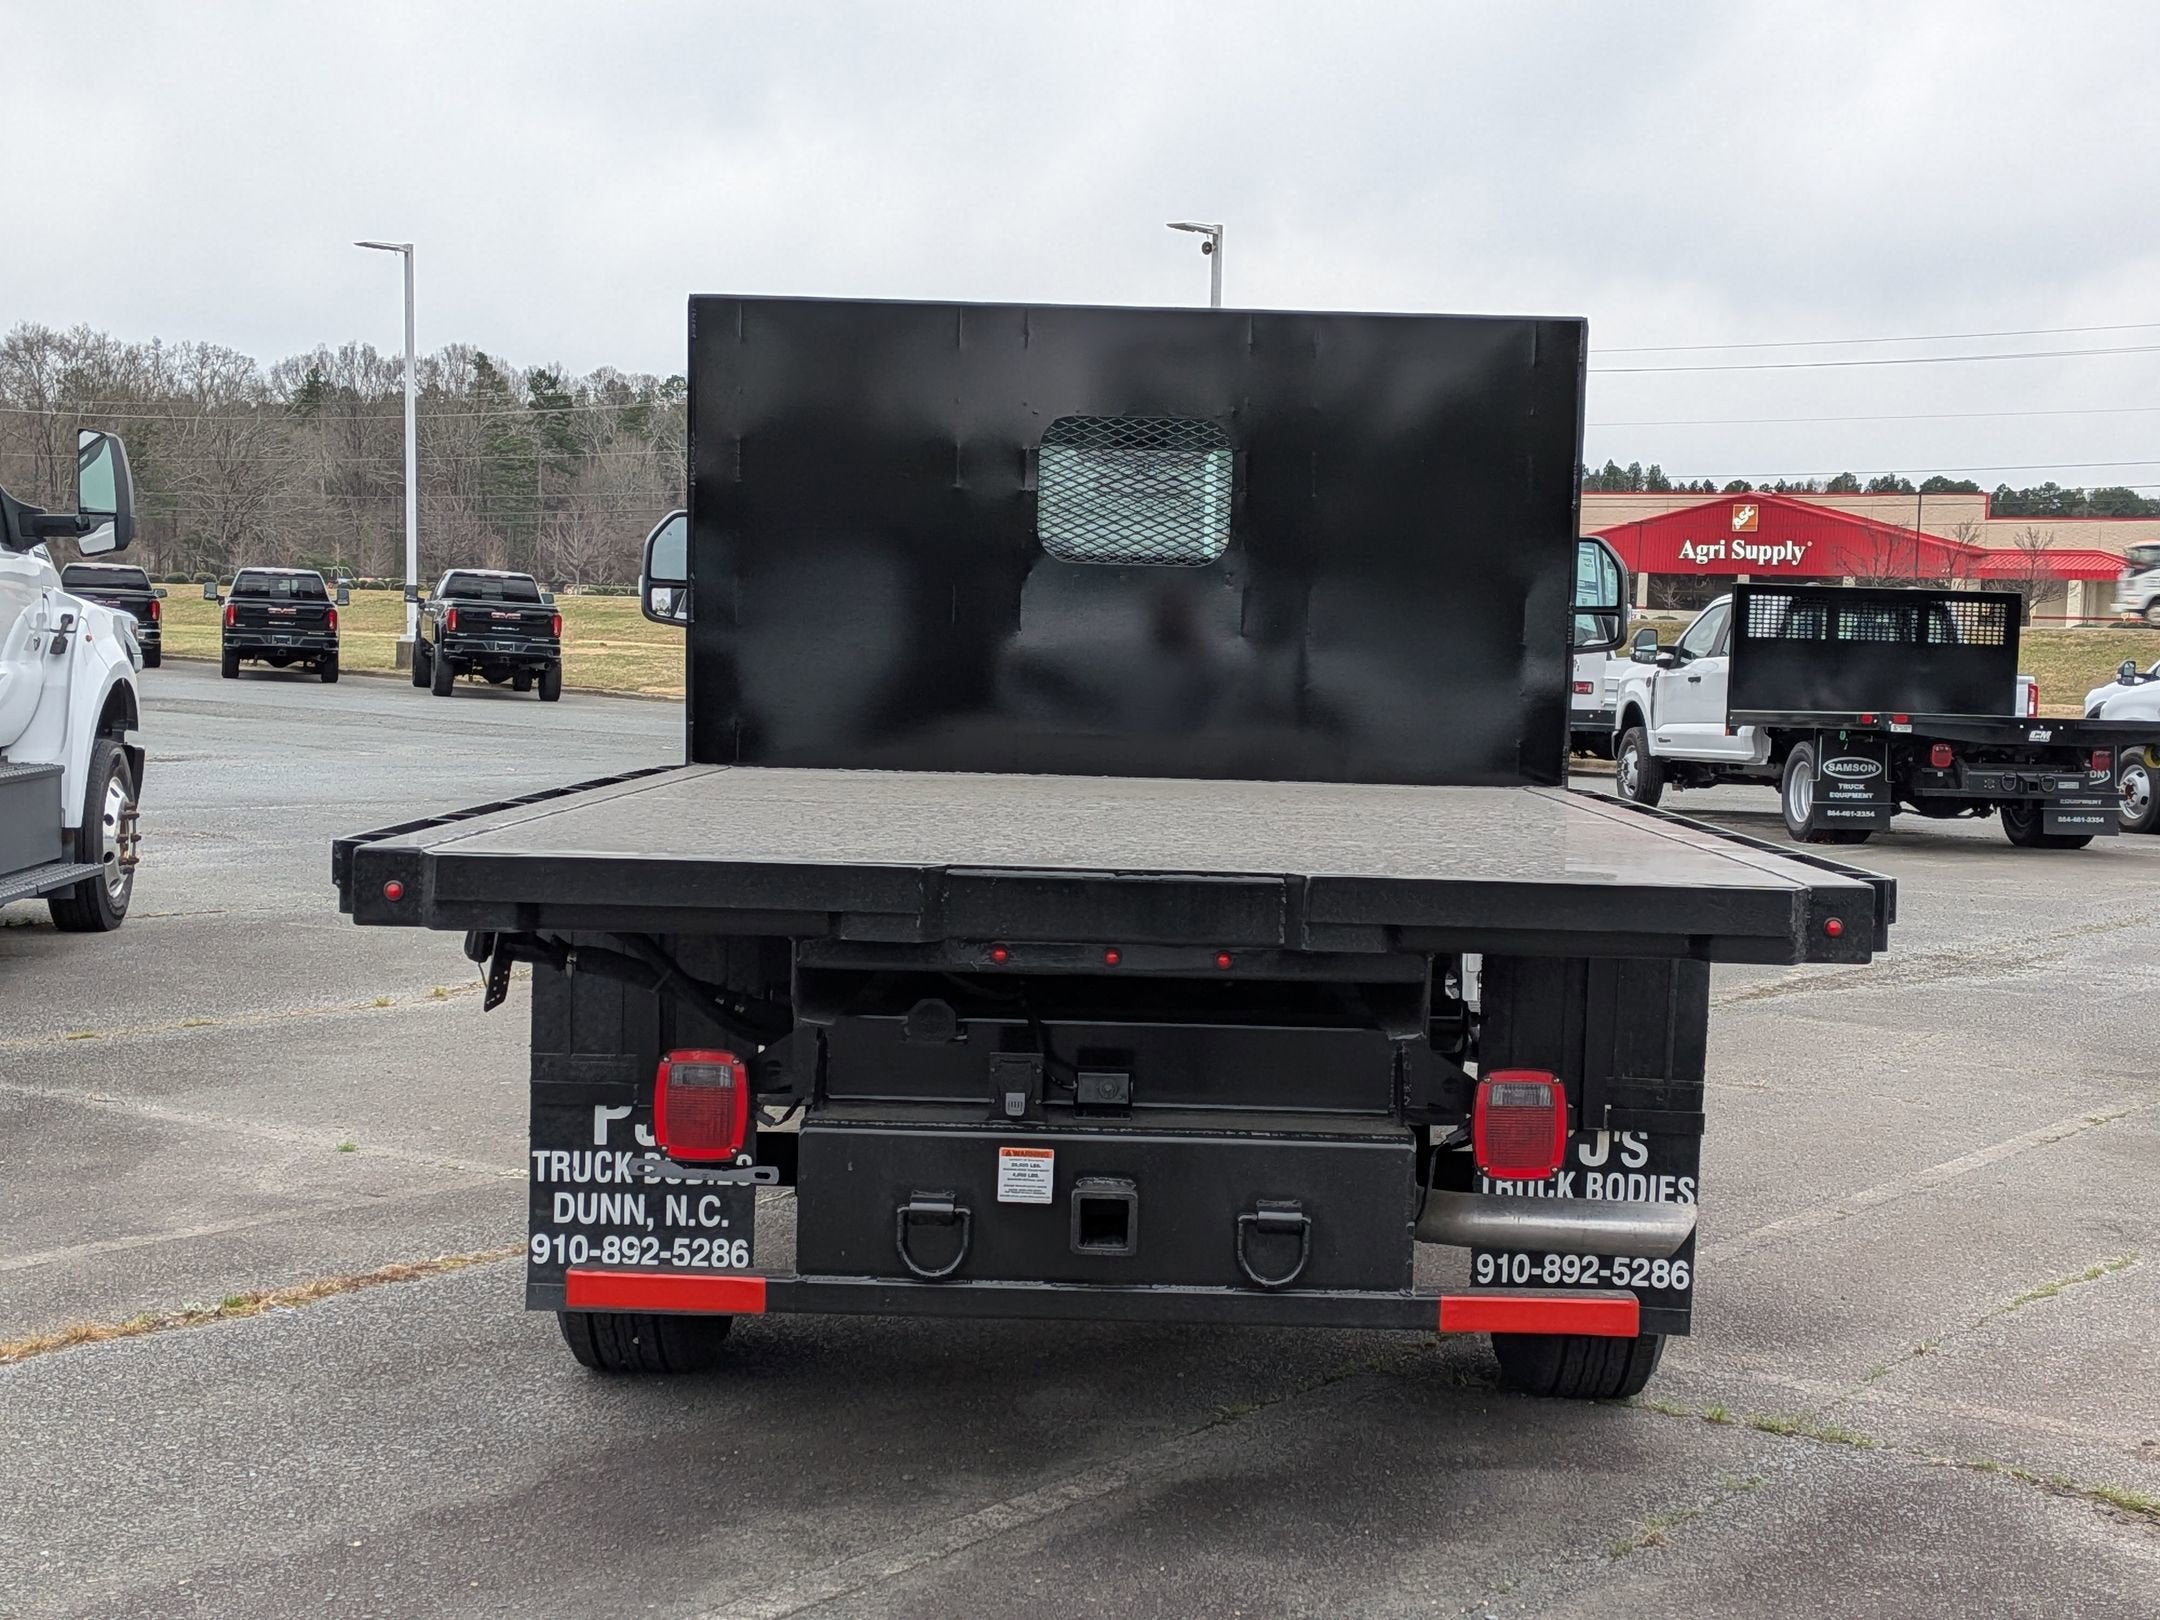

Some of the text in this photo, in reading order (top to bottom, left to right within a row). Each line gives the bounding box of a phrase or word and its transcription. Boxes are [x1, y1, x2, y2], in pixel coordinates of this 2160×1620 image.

[1678, 539, 1806, 566] Agri Supply
[1827, 763, 1877, 773] SAMSON
[1829, 791, 1875, 799] EQUIPMENT
[531, 1150, 634, 1184] TRUCK
[1585, 1171, 1696, 1205] BODIES
[552, 1192, 730, 1231] DUNN, N.C.
[530, 1233, 750, 1268] 910-892-5286
[1476, 1253, 1690, 1290] 910-892-5286
